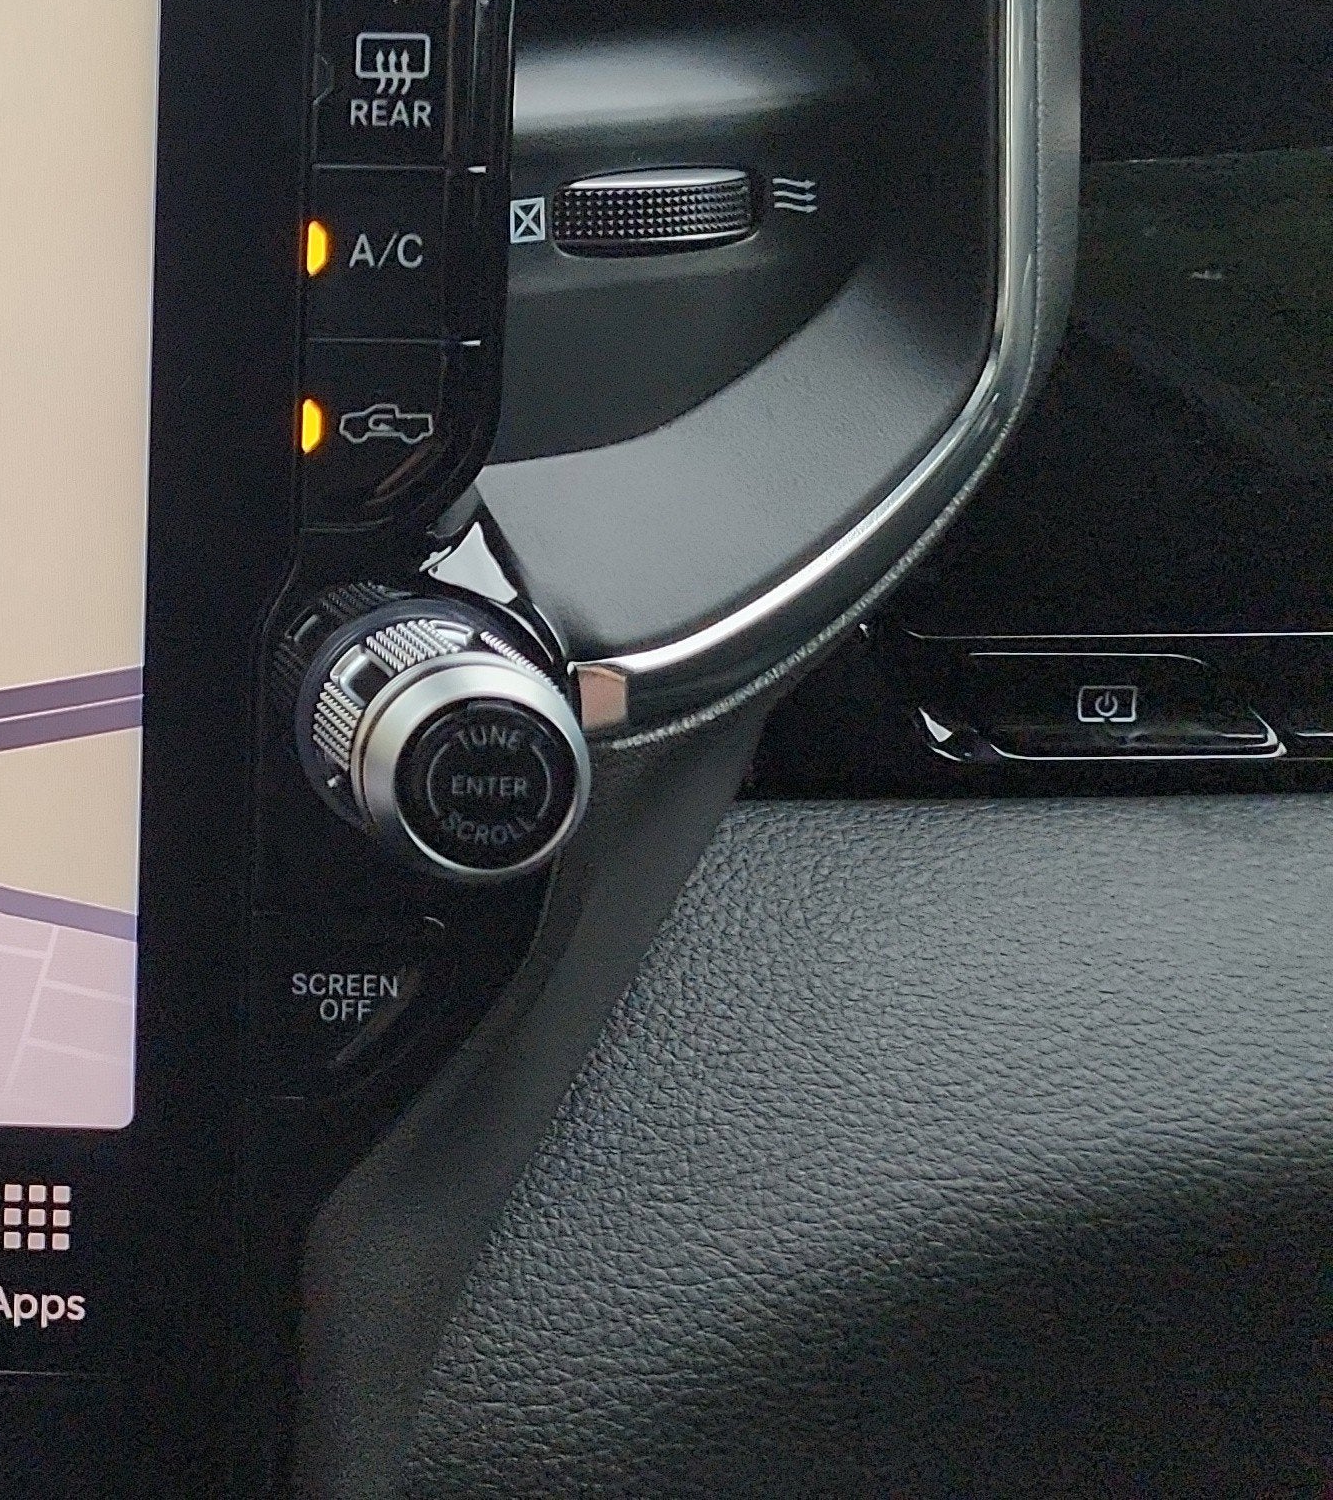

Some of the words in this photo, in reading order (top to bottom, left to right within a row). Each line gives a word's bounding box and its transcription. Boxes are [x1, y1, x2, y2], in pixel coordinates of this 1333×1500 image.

[350, 99, 432, 127] REAR
[348, 231, 423, 268] A/C
[454, 725, 524, 751] TUNE
[451, 774, 528, 797] ENTER
[291, 972, 399, 998] SCREEN
[319, 999, 374, 1022] OFF
